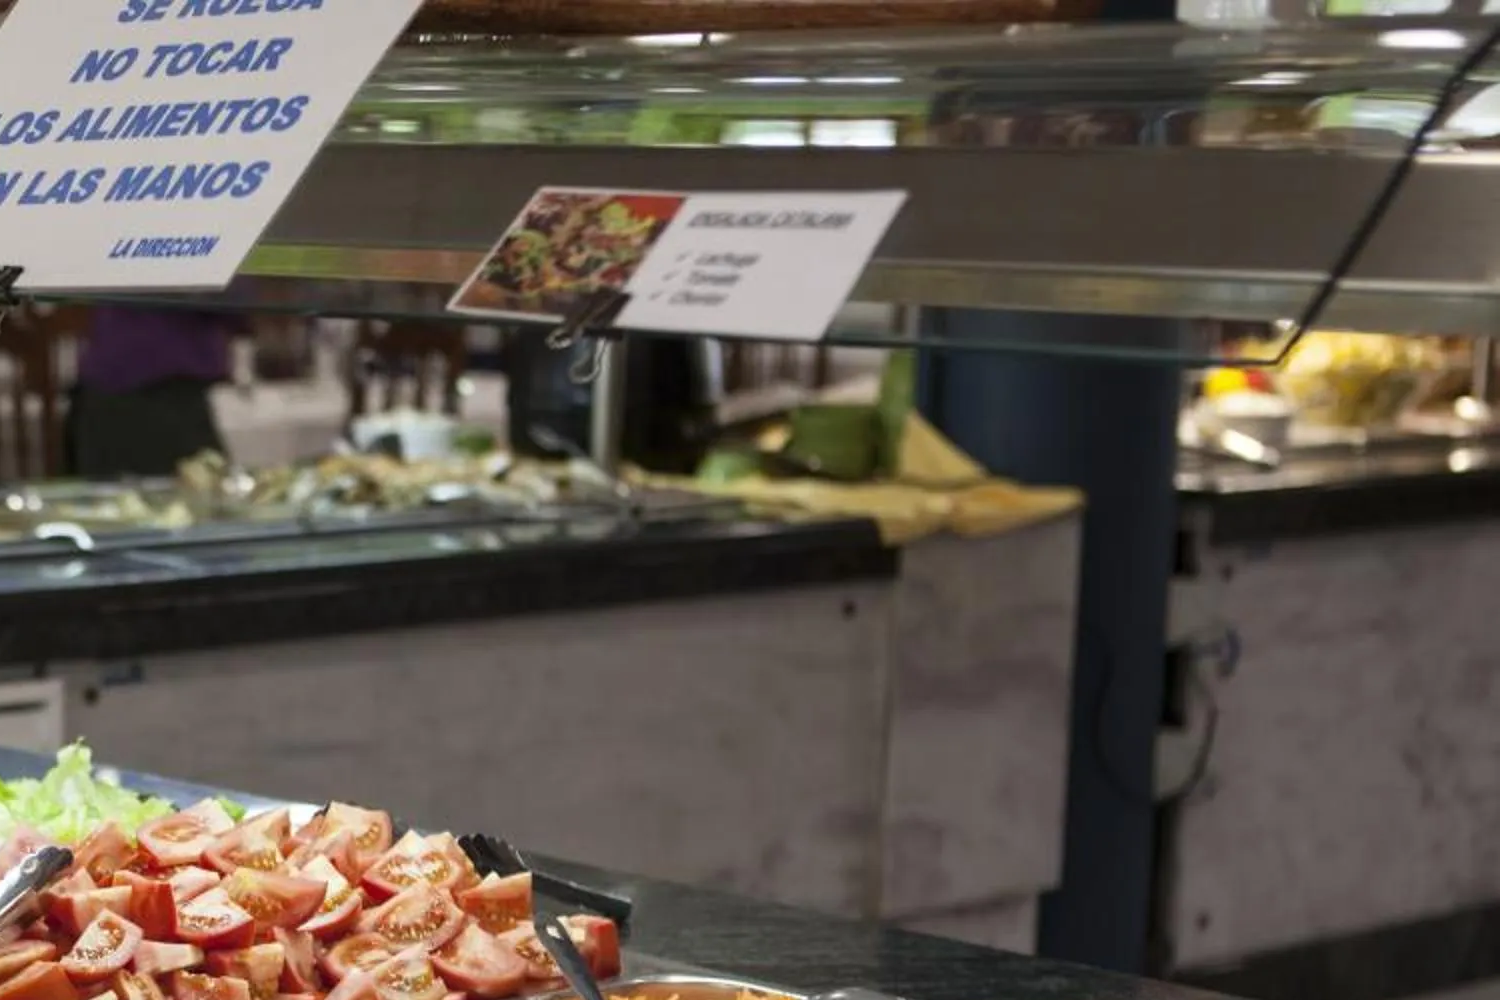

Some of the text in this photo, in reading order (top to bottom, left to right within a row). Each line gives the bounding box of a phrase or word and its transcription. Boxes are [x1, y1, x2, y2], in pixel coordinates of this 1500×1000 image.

[70, 37, 293, 82] NO TOCAR
[55, 95, 310, 142] ALIMENTOS
[17, 168, 107, 206] LAS
[103, 160, 272, 202] MANOS
[108, 235, 221, 258] LA DIRECCION
